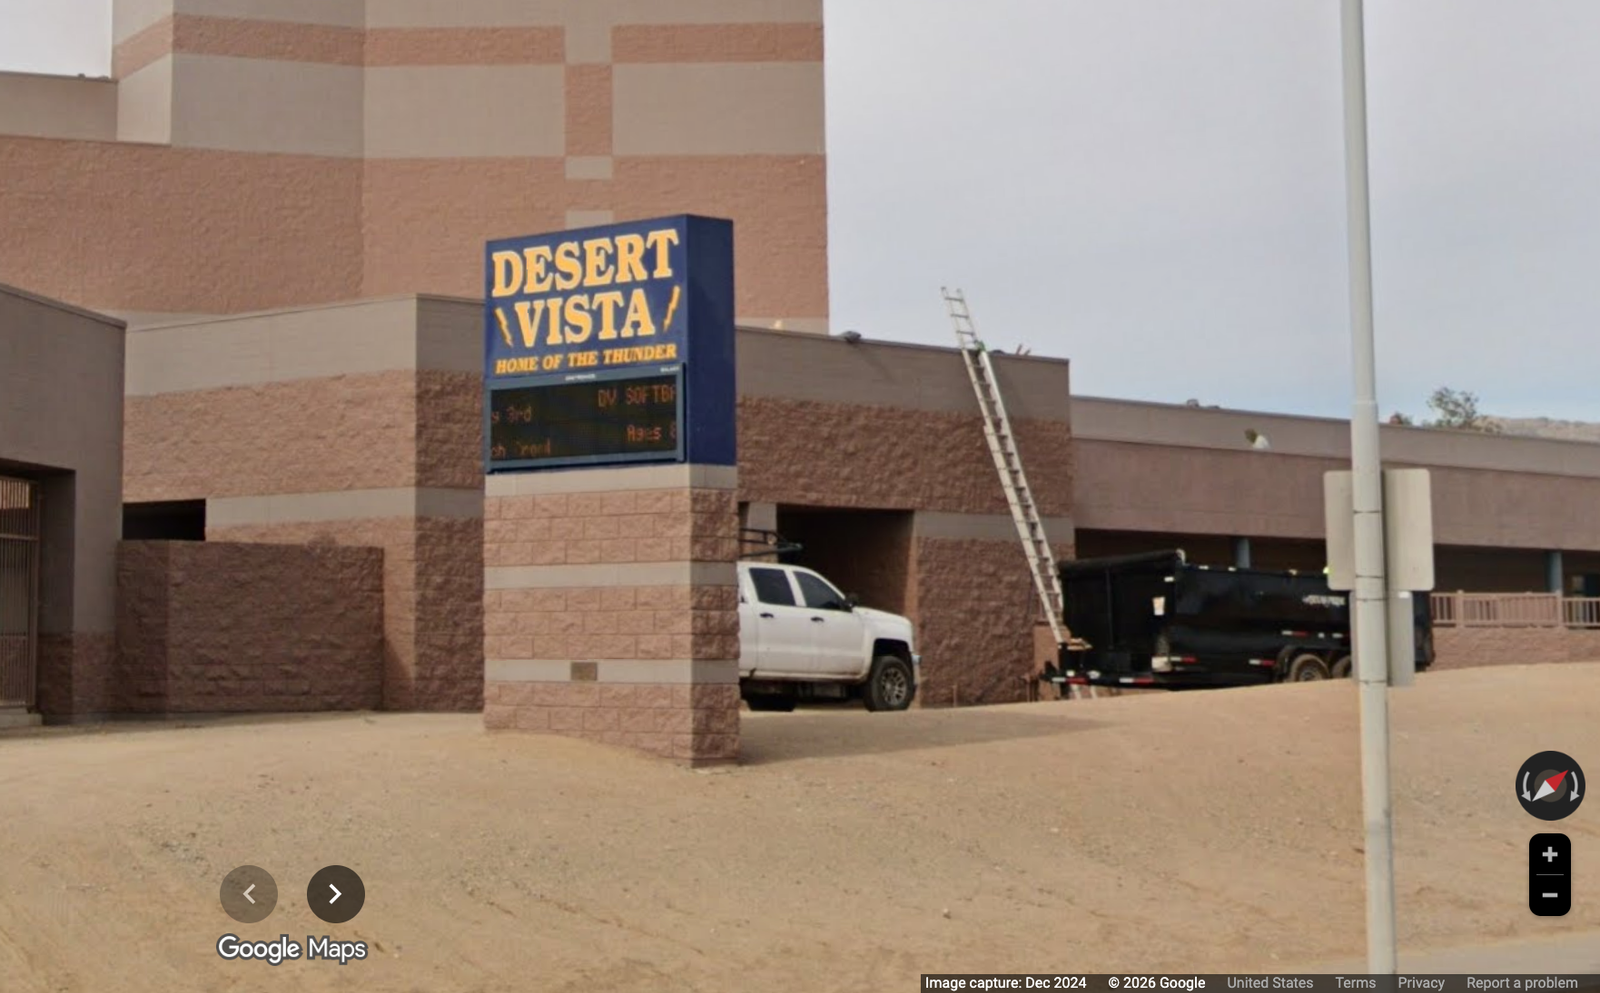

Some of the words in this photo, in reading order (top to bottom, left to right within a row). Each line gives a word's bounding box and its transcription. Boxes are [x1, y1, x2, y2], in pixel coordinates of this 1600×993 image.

[492, 229, 679, 297] DESERT
[515, 288, 656, 348] VISTA
[495, 357, 539, 374] HOME
[542, 353, 564, 370] OF
[568, 351, 599, 367] THE
[603, 344, 678, 364] THUNDER
